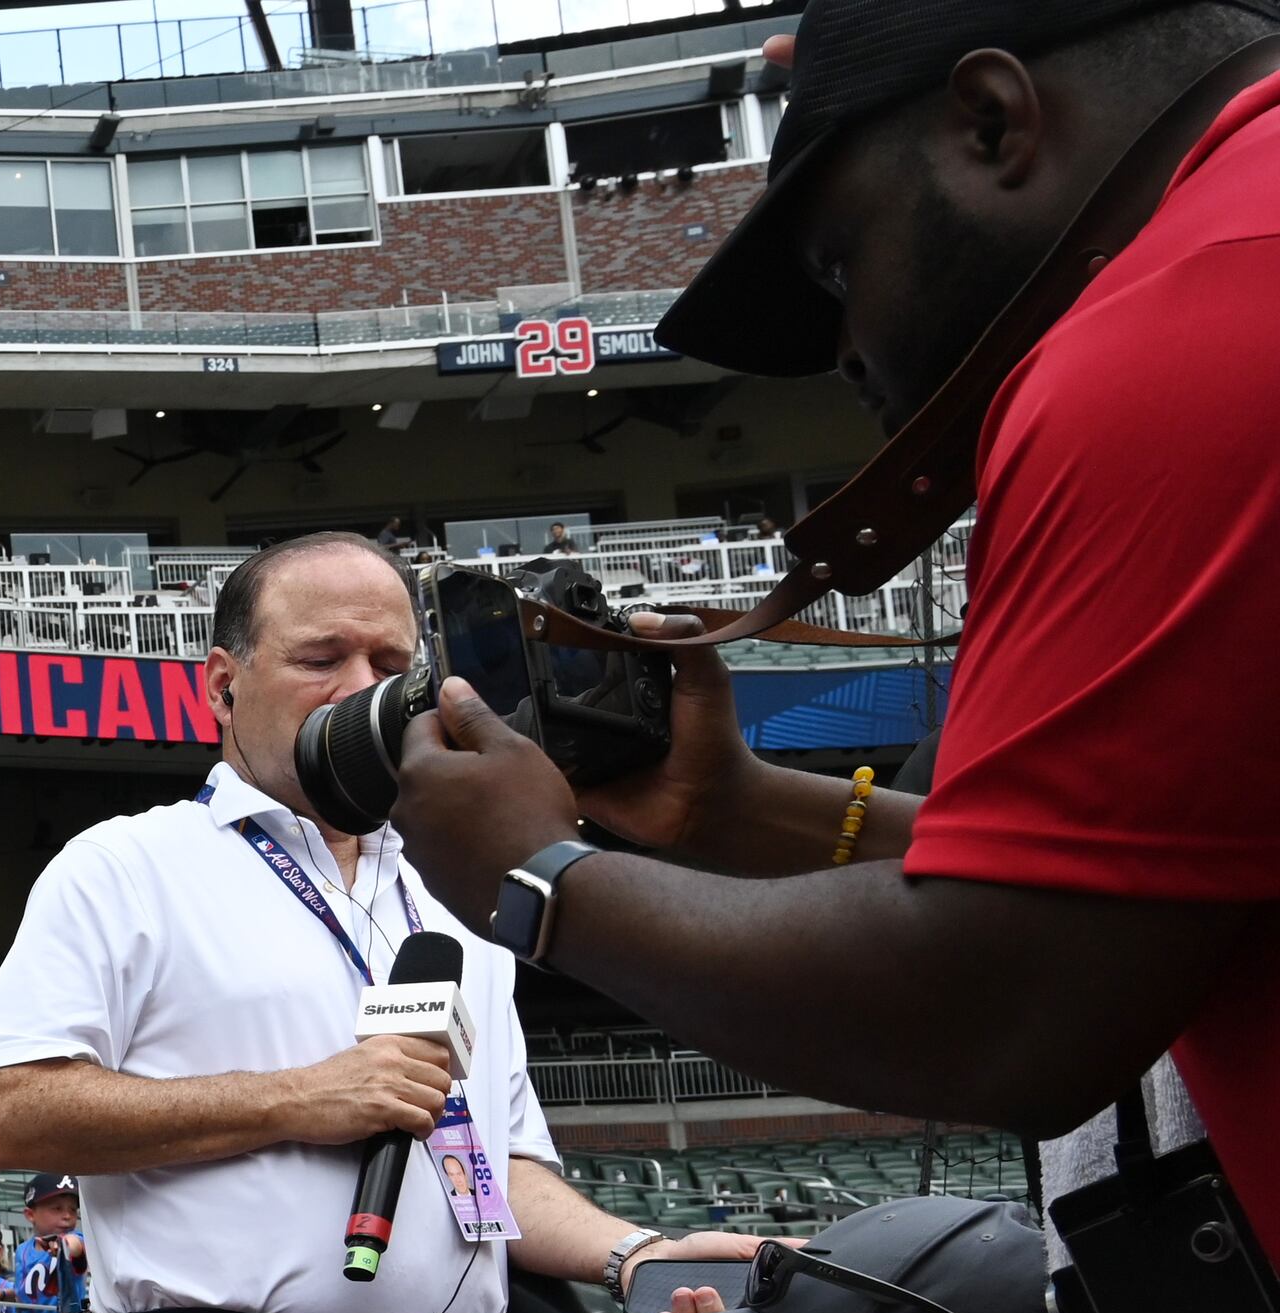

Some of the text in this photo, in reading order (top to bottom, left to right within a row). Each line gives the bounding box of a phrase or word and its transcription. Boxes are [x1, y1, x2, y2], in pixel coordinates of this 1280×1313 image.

[456, 316, 670, 378] JOHN 29 SMOLT
[207, 358, 235, 371] 324
[364, 1001, 446, 1016] SiriusXM
